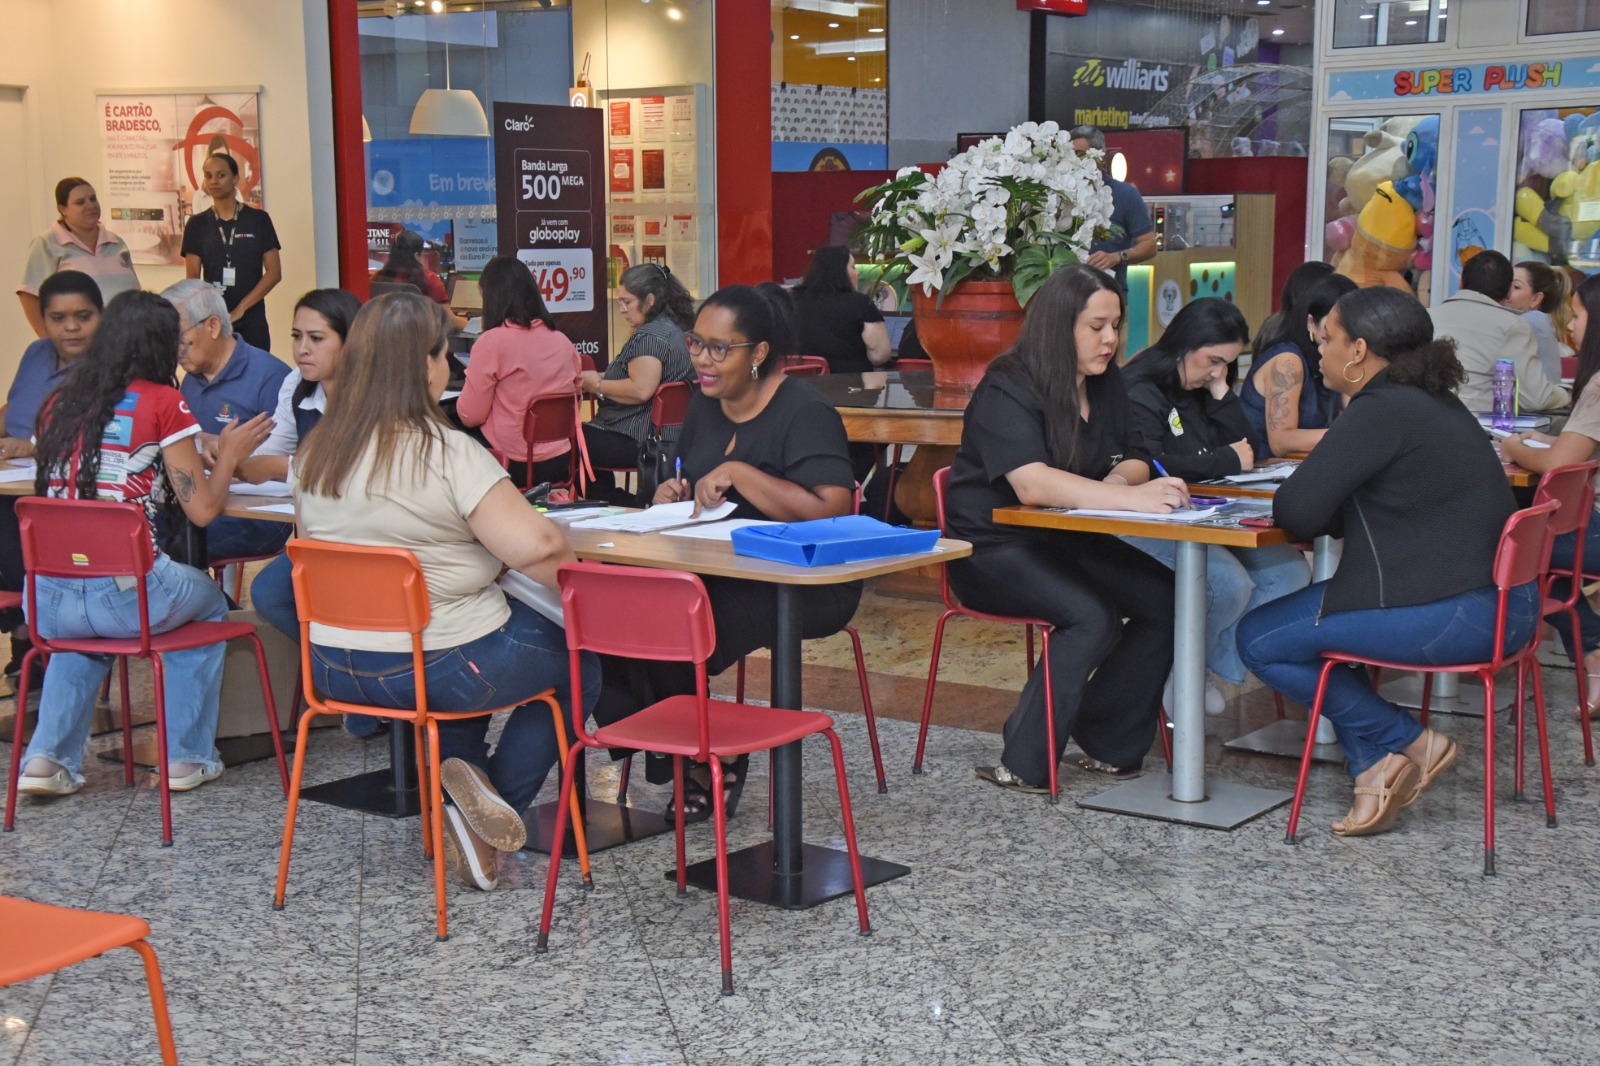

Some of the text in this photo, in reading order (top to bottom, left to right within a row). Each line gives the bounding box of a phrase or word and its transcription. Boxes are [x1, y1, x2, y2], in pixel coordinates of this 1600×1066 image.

[1106, 58, 1169, 91] williarts
[1394, 62, 1562, 95] SUPER PLUSH
[105, 102, 152, 117] É CARTÃO
[1074, 106, 1128, 129] marketing
[106, 120, 161, 133] BRADESCO,
[505, 117, 531, 131] Claro
[522, 160, 568, 174] Banda Larga
[429, 173, 453, 192] Em
[522, 175, 584, 200] 500 MEGA
[541, 218, 546, 226] Já
[529, 226, 580, 244] globoplay
